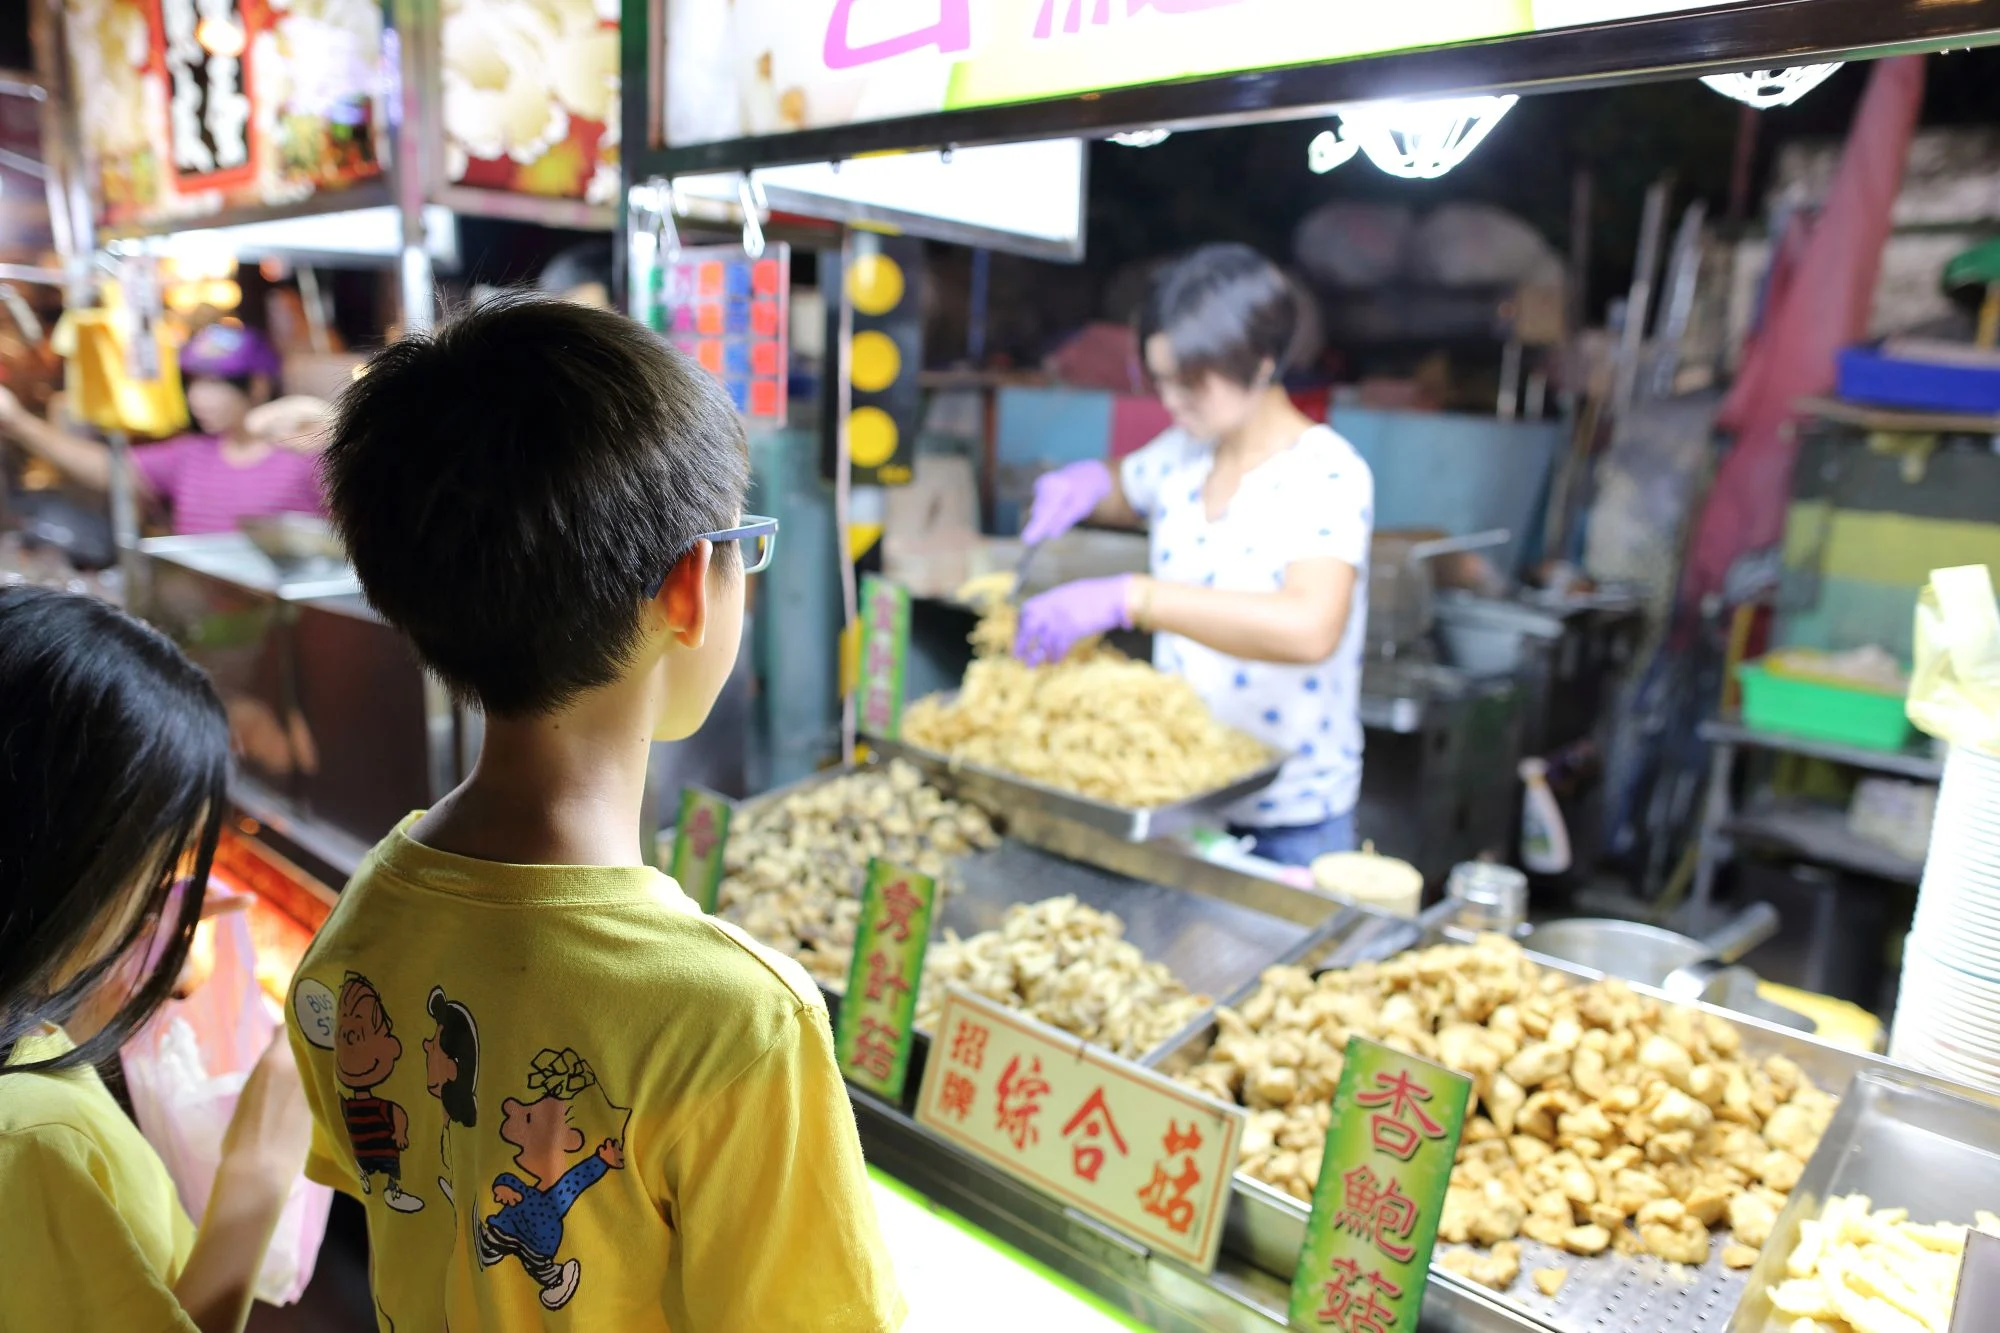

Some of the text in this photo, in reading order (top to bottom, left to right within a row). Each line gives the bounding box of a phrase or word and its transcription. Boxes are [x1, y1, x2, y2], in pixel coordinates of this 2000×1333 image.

[939, 1019, 989, 1121] 招牌
[996, 1054, 1203, 1234] 綜合菇
[1316, 1070, 1446, 1333] 杏鮑菇
